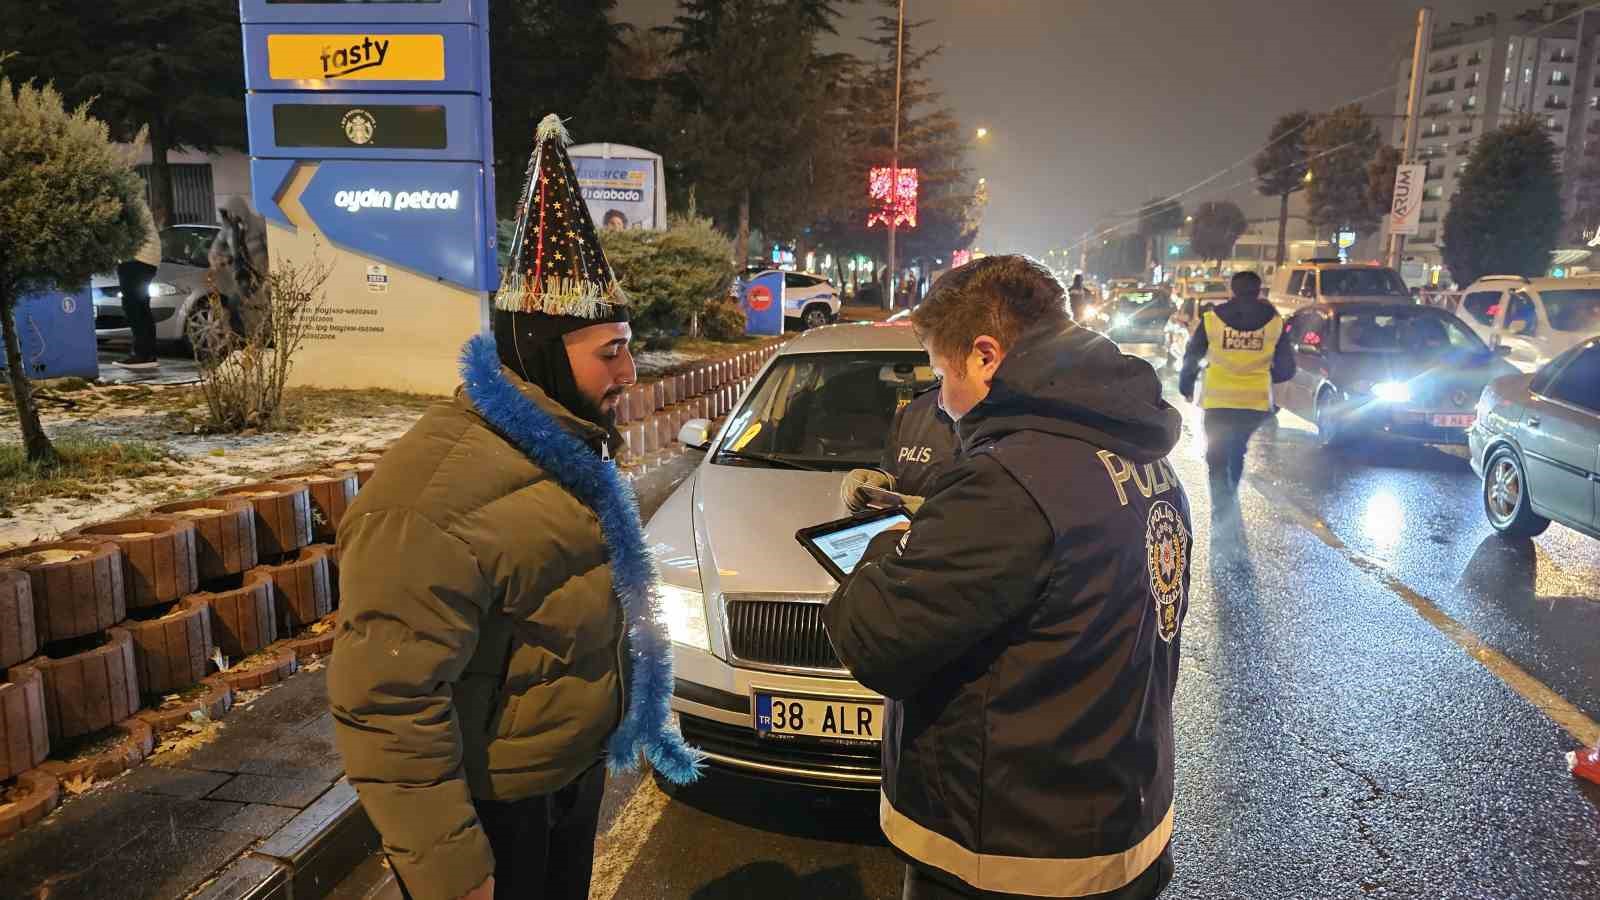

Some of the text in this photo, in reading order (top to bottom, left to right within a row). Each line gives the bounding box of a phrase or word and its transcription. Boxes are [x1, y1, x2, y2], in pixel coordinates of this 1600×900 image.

[393, 190, 459, 211] petrol
[760, 715, 771, 725] TR
[772, 700, 873, 736] 38 ALR
